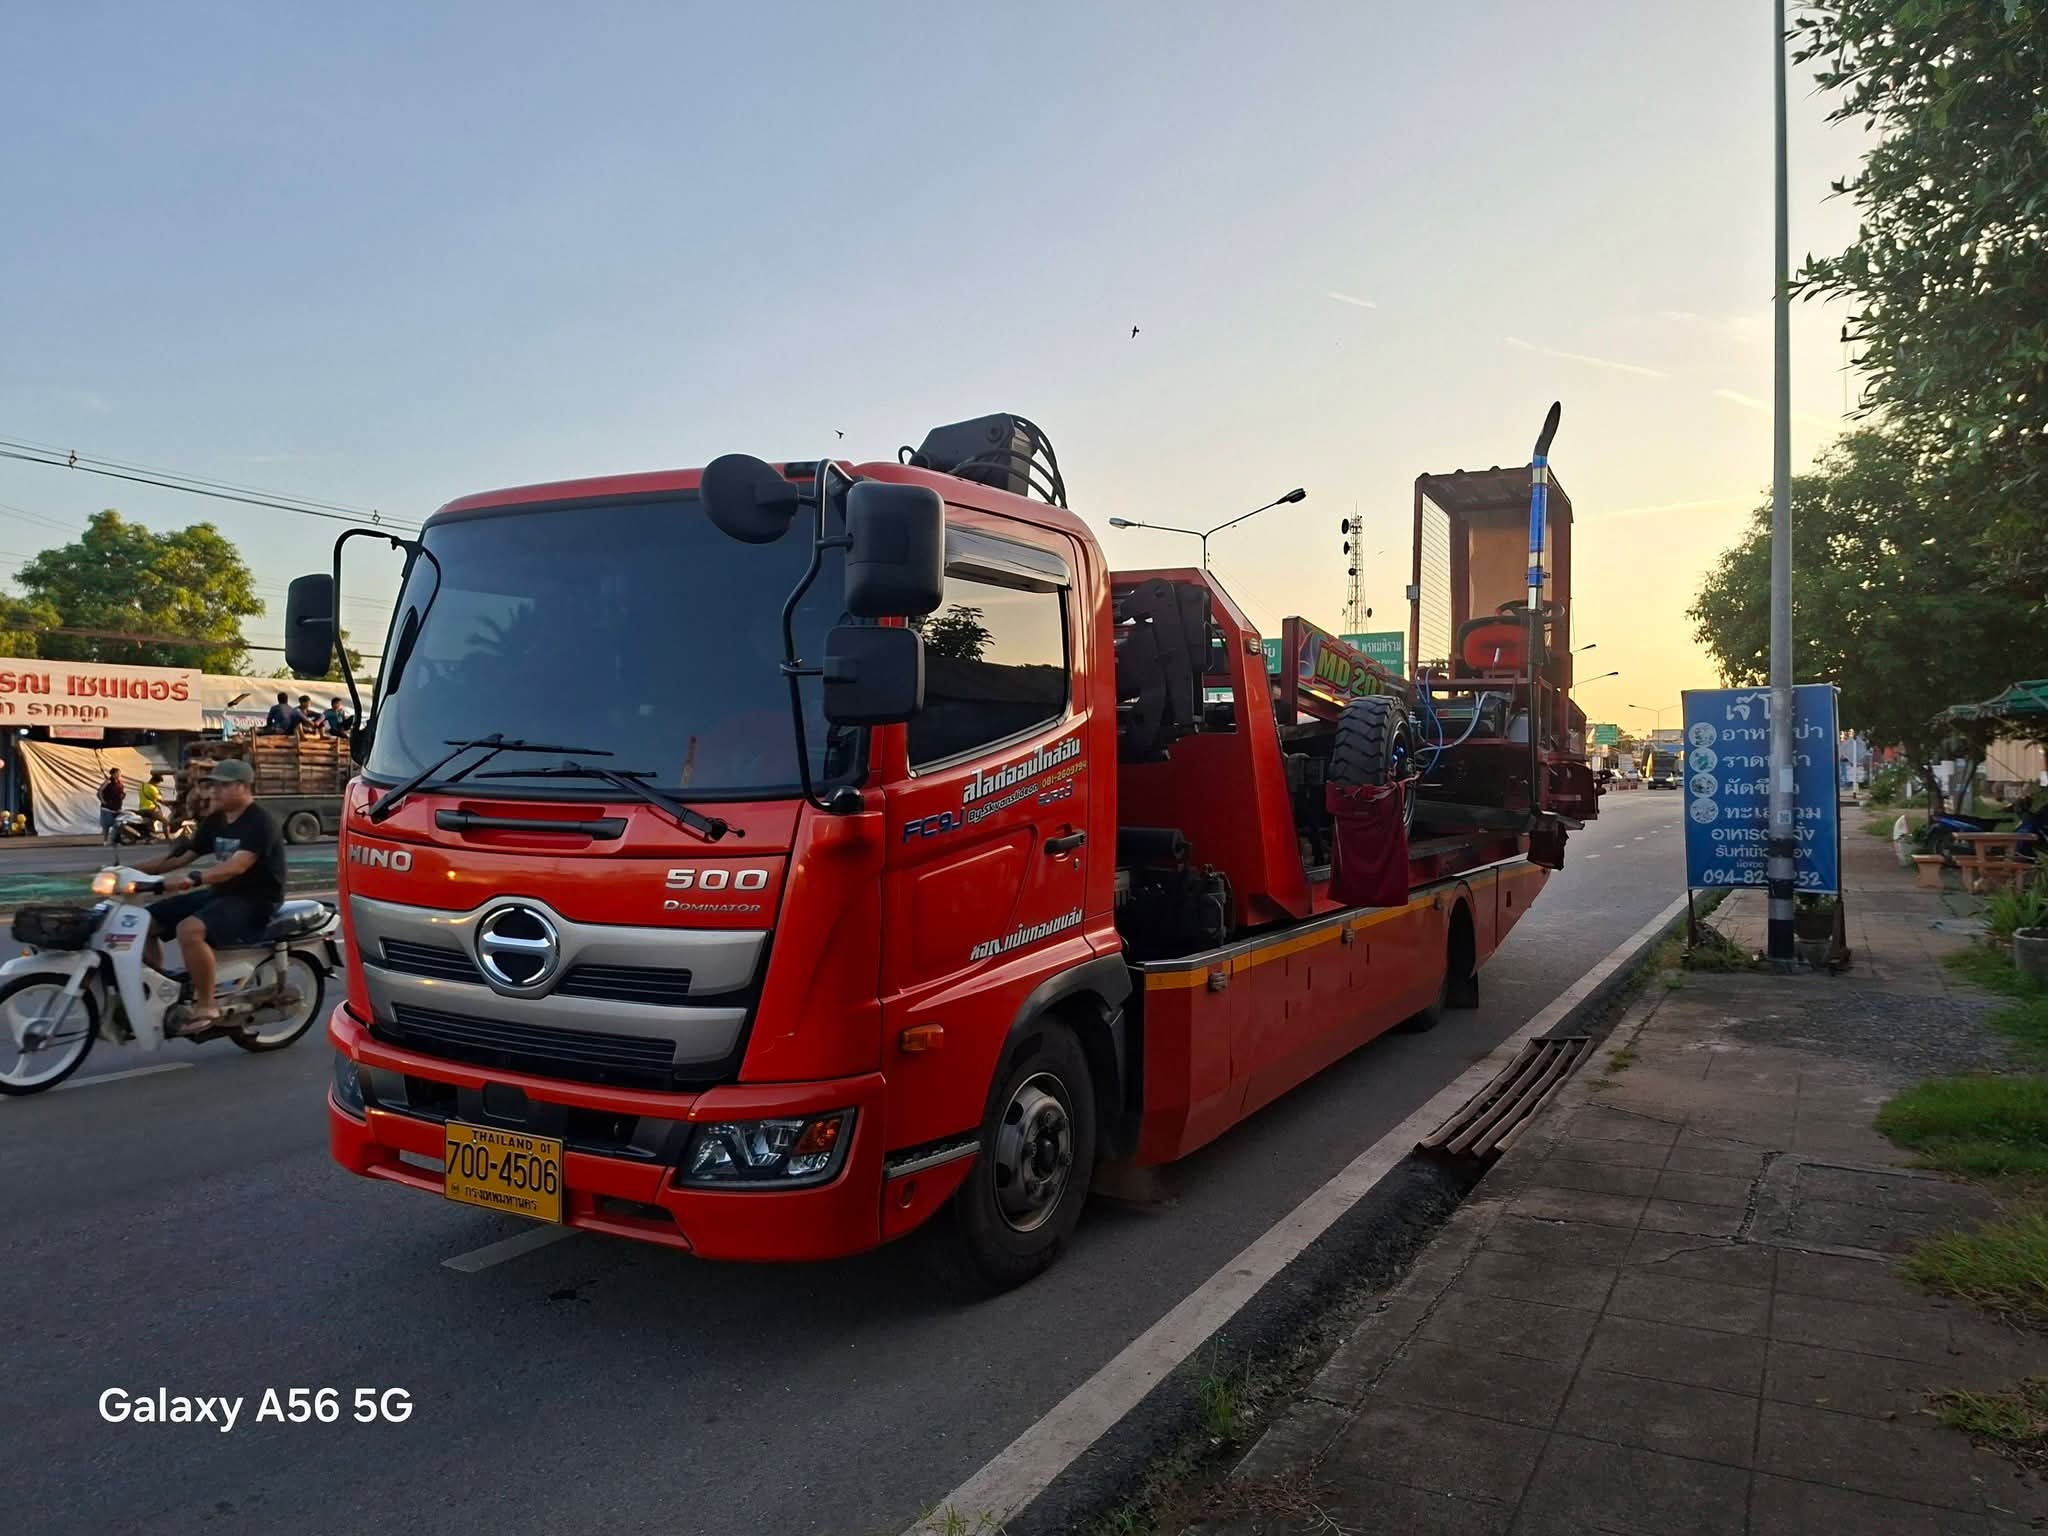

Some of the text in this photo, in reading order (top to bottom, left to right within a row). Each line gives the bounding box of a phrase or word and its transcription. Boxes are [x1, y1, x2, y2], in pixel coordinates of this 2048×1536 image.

[1317, 648, 1351, 687] MD
[27, 702, 109, 723] ราคาถูก
[902, 807, 965, 844] FC9J
[349, 844, 412, 872] HINO
[664, 868, 769, 891] 500
[473, 1131, 532, 1150] THAILAND
[448, 1141, 557, 1195] 700-4506
